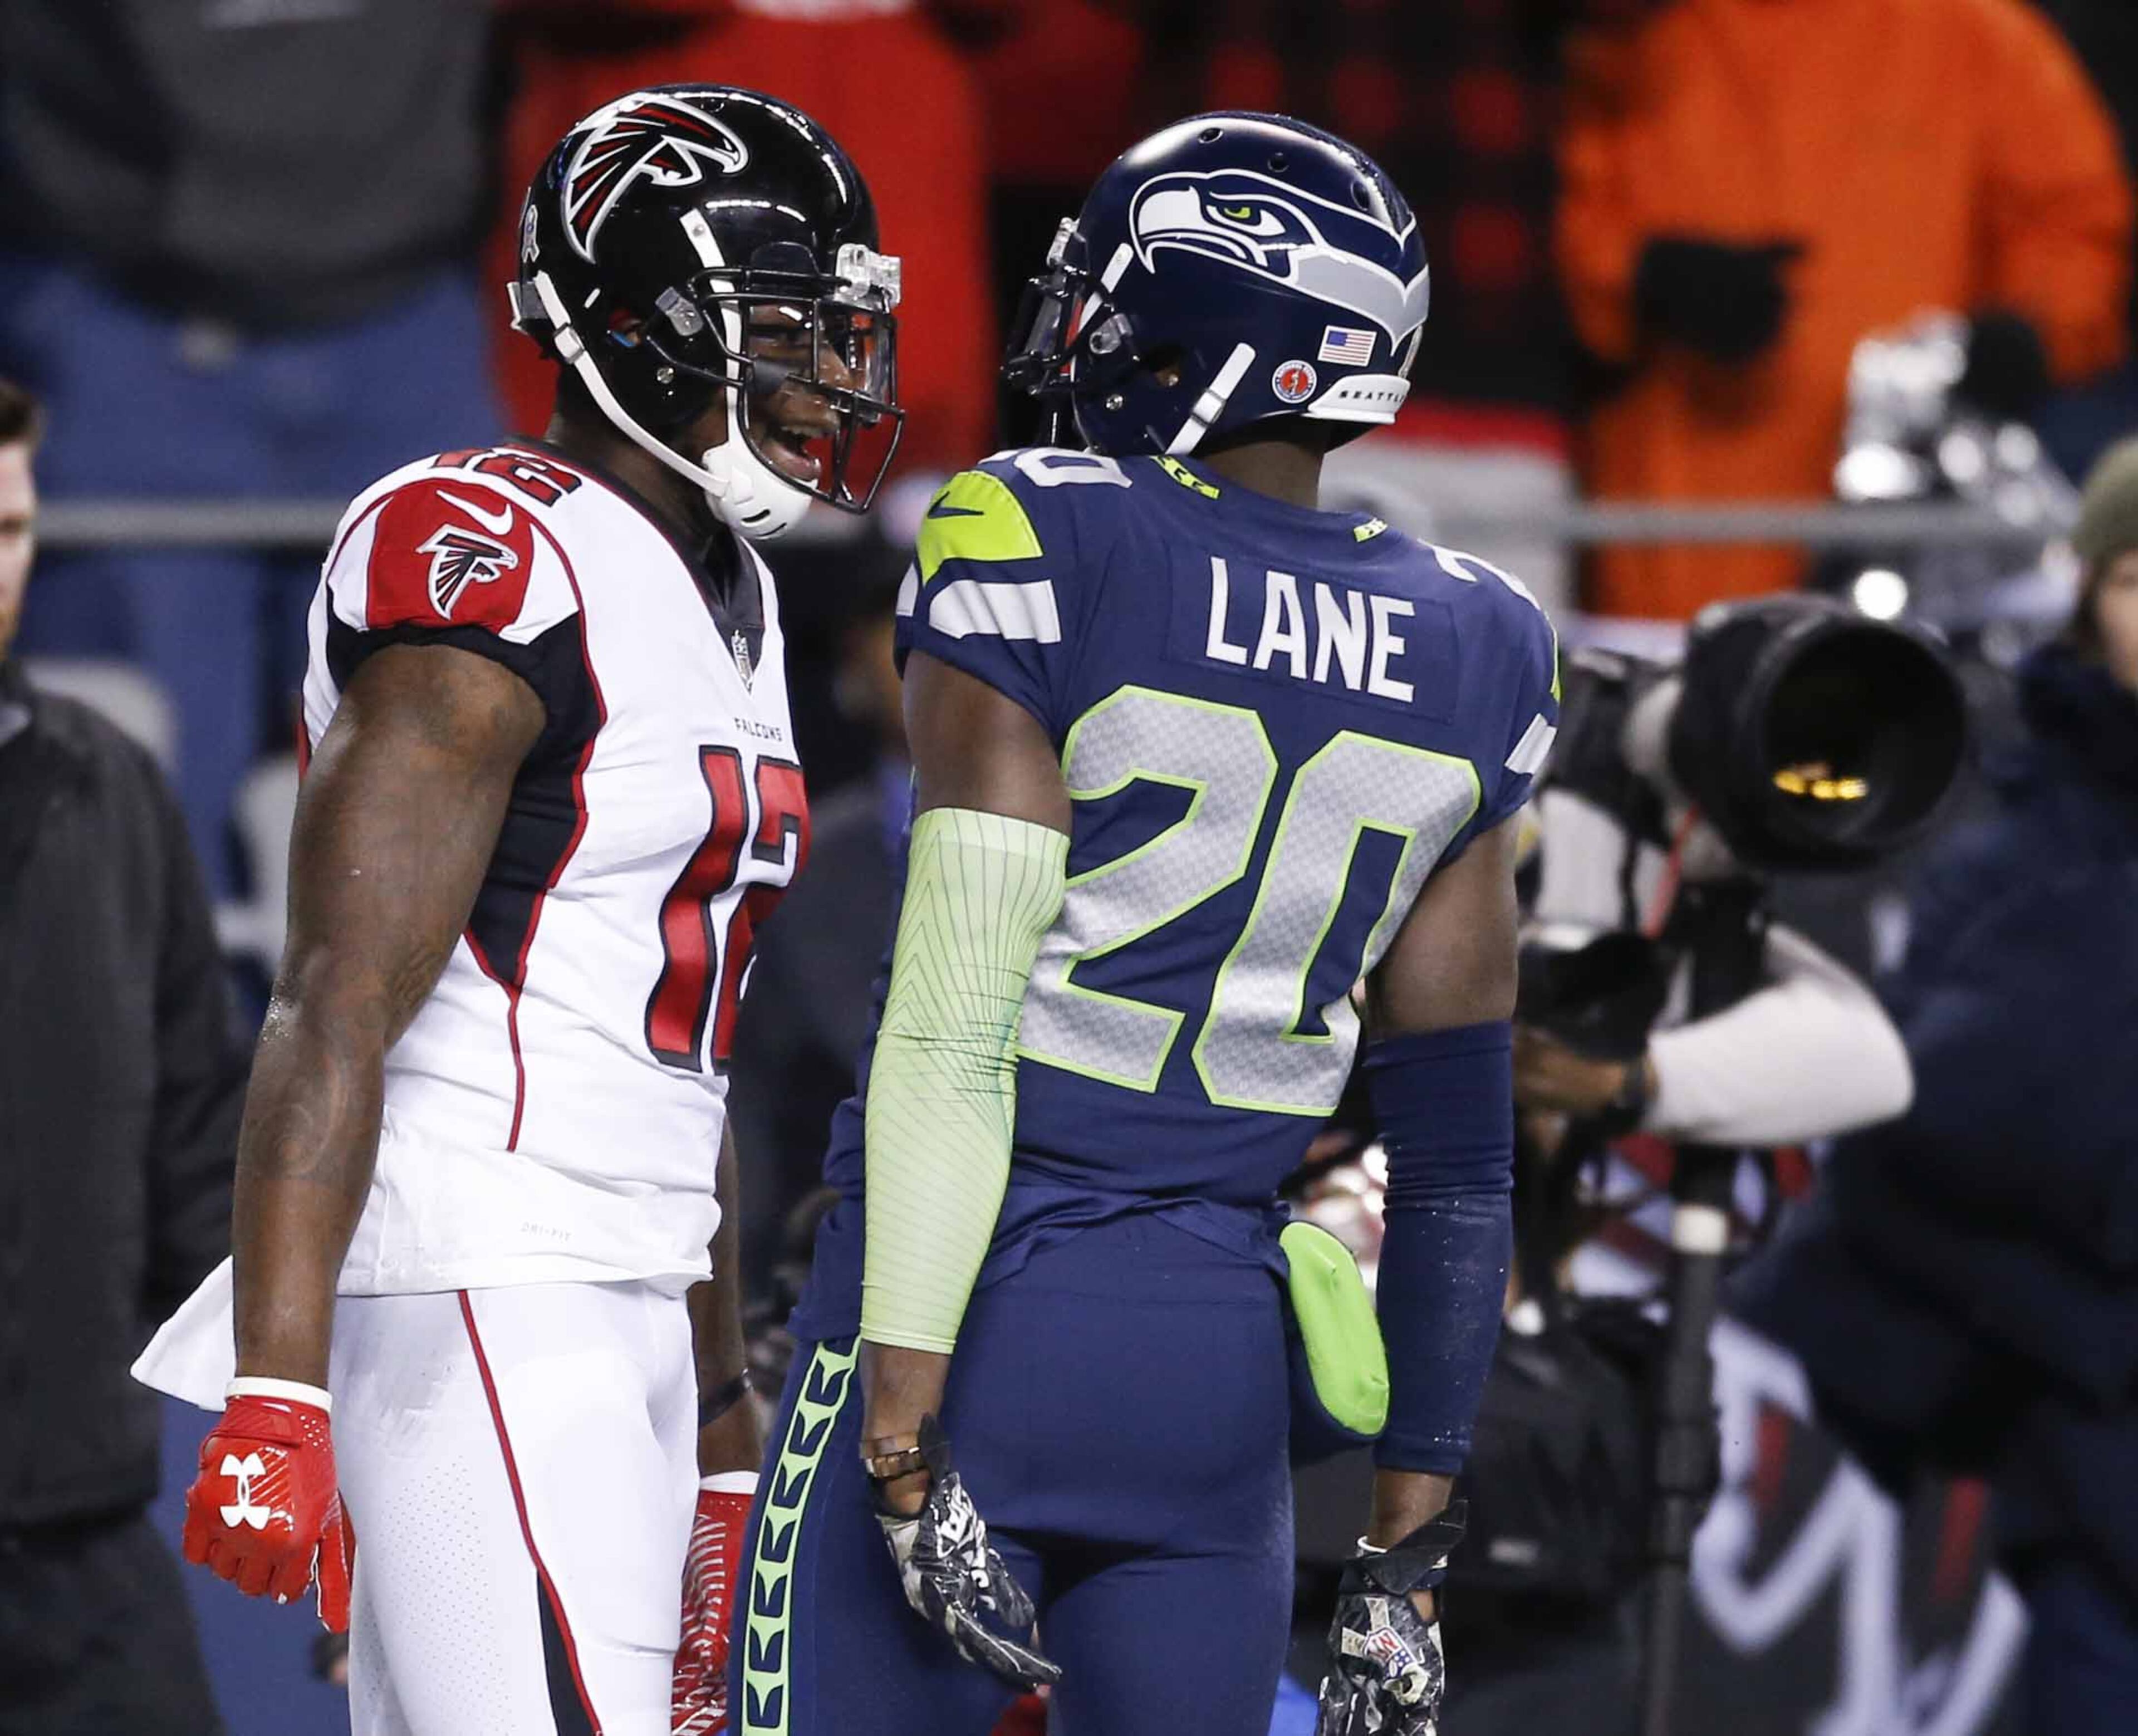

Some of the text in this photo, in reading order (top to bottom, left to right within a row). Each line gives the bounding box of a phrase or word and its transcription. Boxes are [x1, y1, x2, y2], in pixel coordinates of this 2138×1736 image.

[734, 717, 783, 743] FALCONS
[1206, 556, 1415, 703] LANE
[644, 744, 812, 1076] 12
[1016, 684, 1482, 1117] 20
